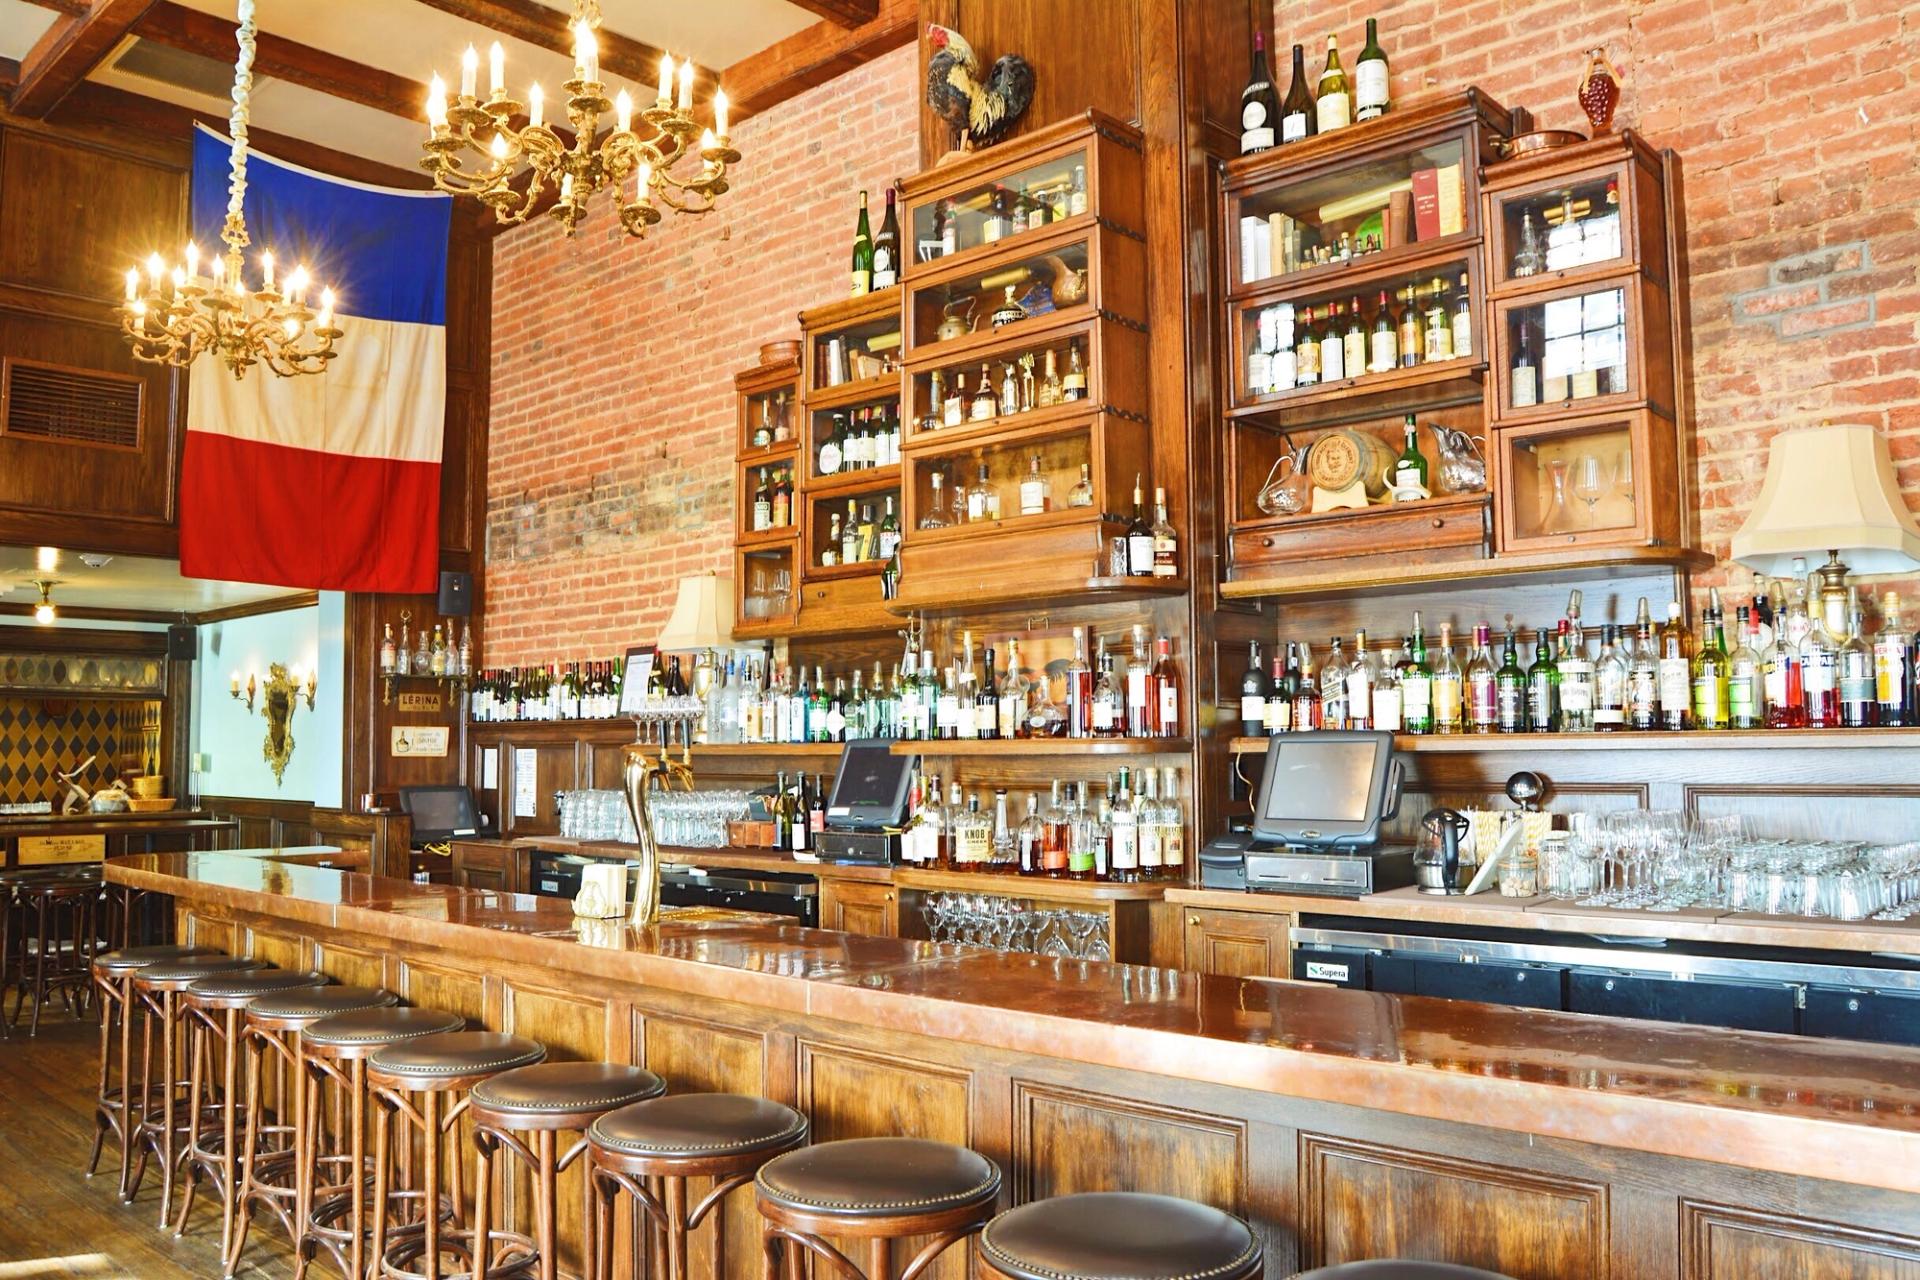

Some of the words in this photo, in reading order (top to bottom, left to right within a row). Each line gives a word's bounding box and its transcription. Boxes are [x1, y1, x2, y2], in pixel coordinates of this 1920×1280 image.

[402, 694, 439, 705] LÉRINA
[964, 829, 985, 839] KNOB
[1319, 966, 1346, 978] Supera
